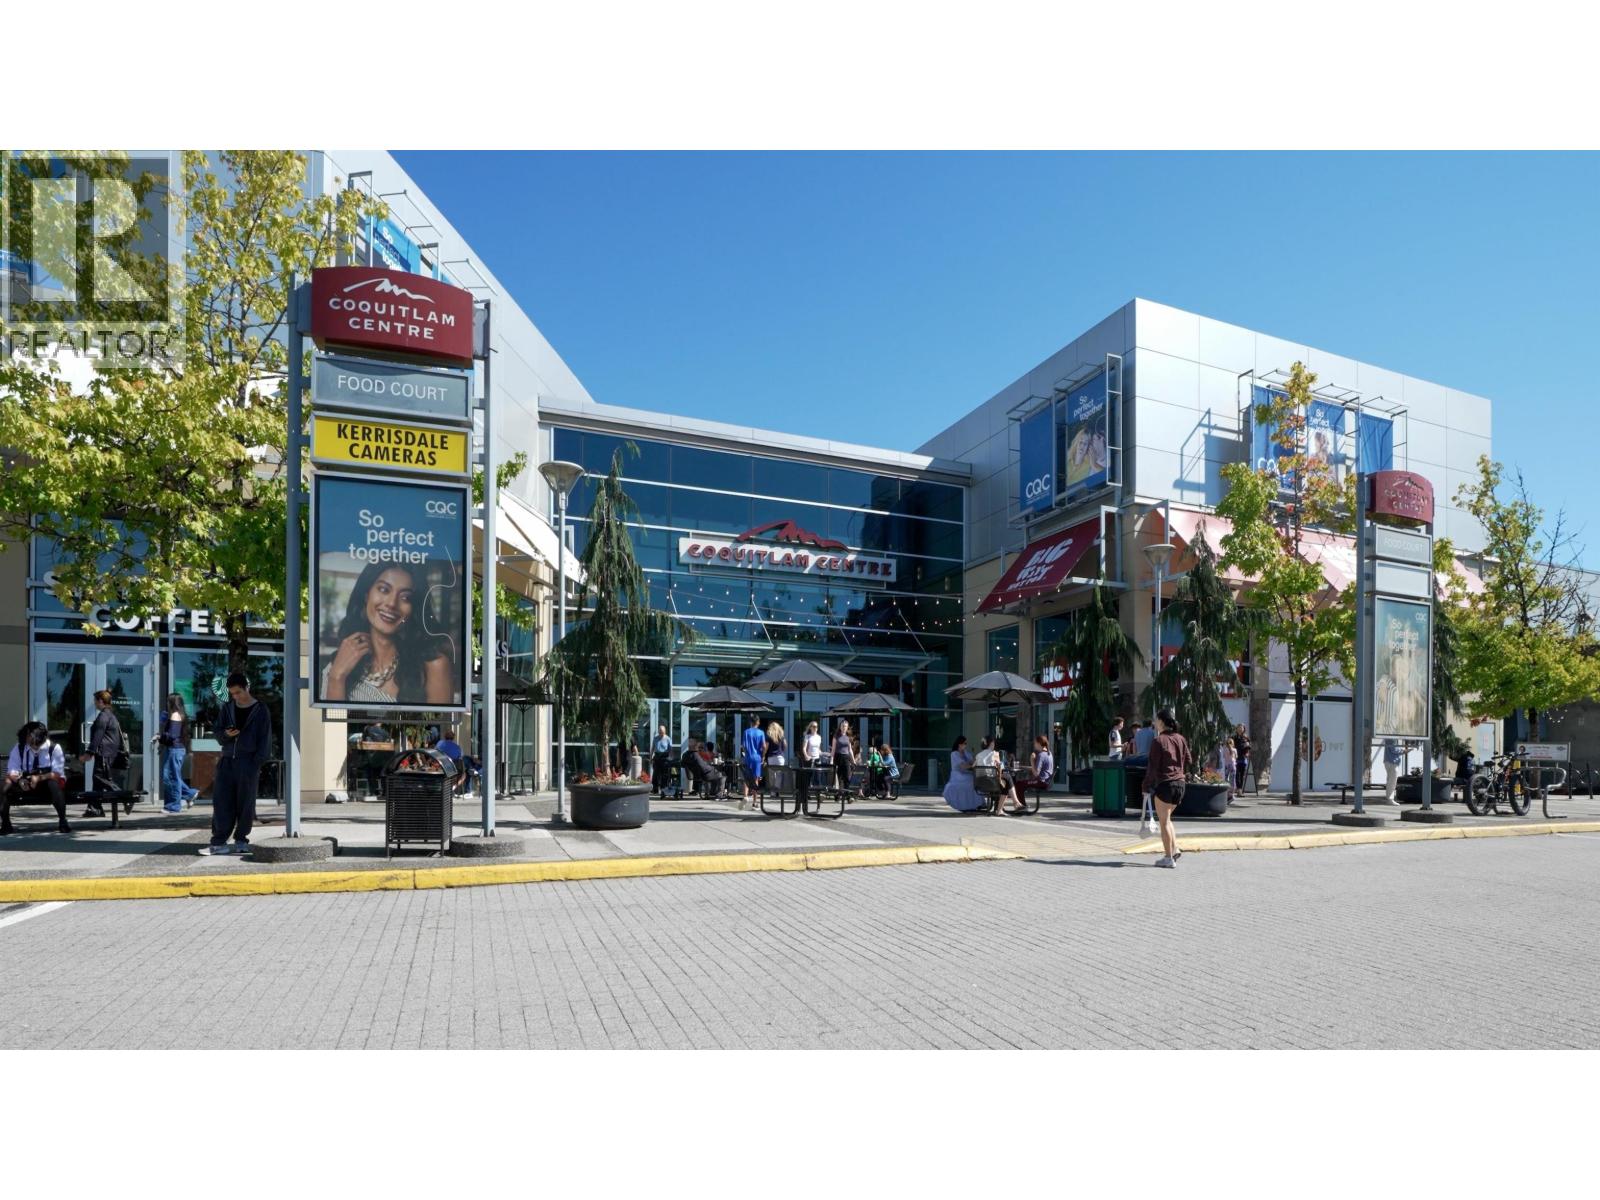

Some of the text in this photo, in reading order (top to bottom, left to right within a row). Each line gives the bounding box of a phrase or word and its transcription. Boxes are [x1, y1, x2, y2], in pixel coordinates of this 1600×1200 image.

[329, 298, 455, 327] COQUITLAM
[349, 317, 435, 340] CENTRE
[338, 375, 448, 401] FOOD COURT
[337, 423, 449, 450] KERRISDALE
[349, 443, 437, 466] CAMERAS
[1025, 473, 1051, 499] CQC
[359, 509, 384, 528] So
[425, 500, 457, 515] CQC
[367, 528, 434, 547] perfect
[349, 543, 429, 565] together
[688, 544, 892, 577] COQUITLAM CENTRE
